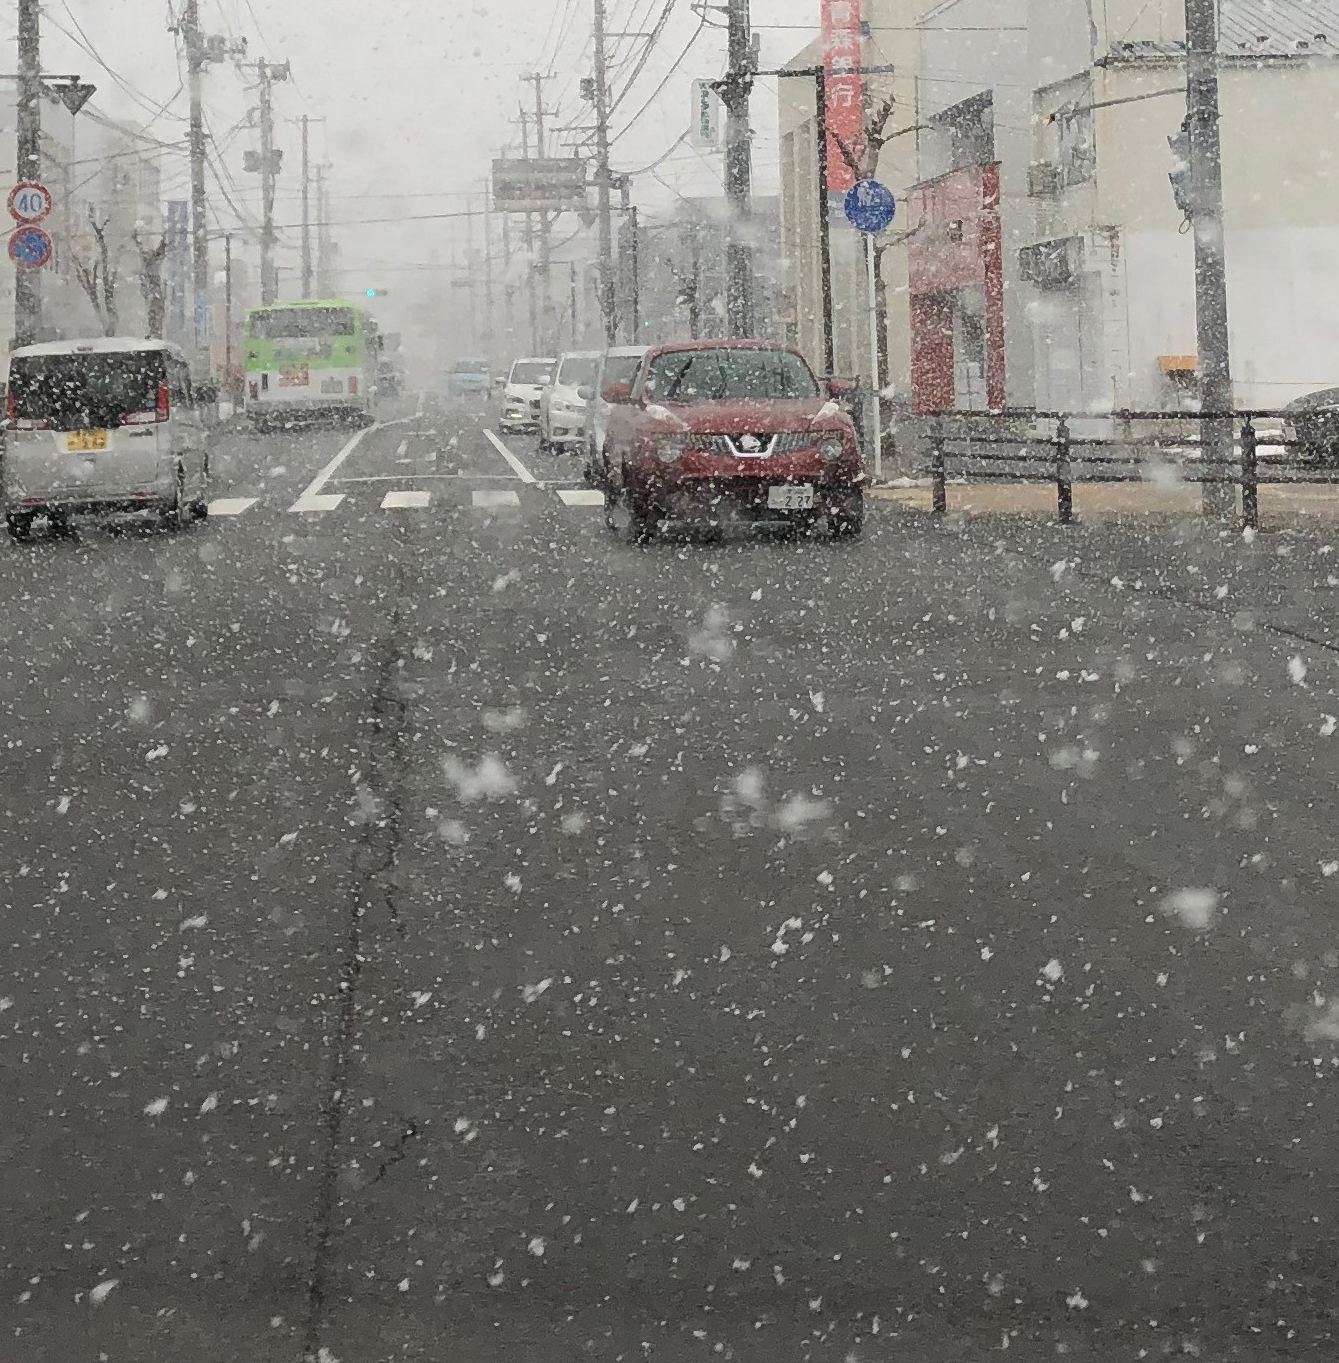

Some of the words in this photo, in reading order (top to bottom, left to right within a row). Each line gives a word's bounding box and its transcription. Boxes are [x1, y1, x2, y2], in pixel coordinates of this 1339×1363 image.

[829, 0, 855, 107] 青森銀行
[19, 193, 42, 213] 40
